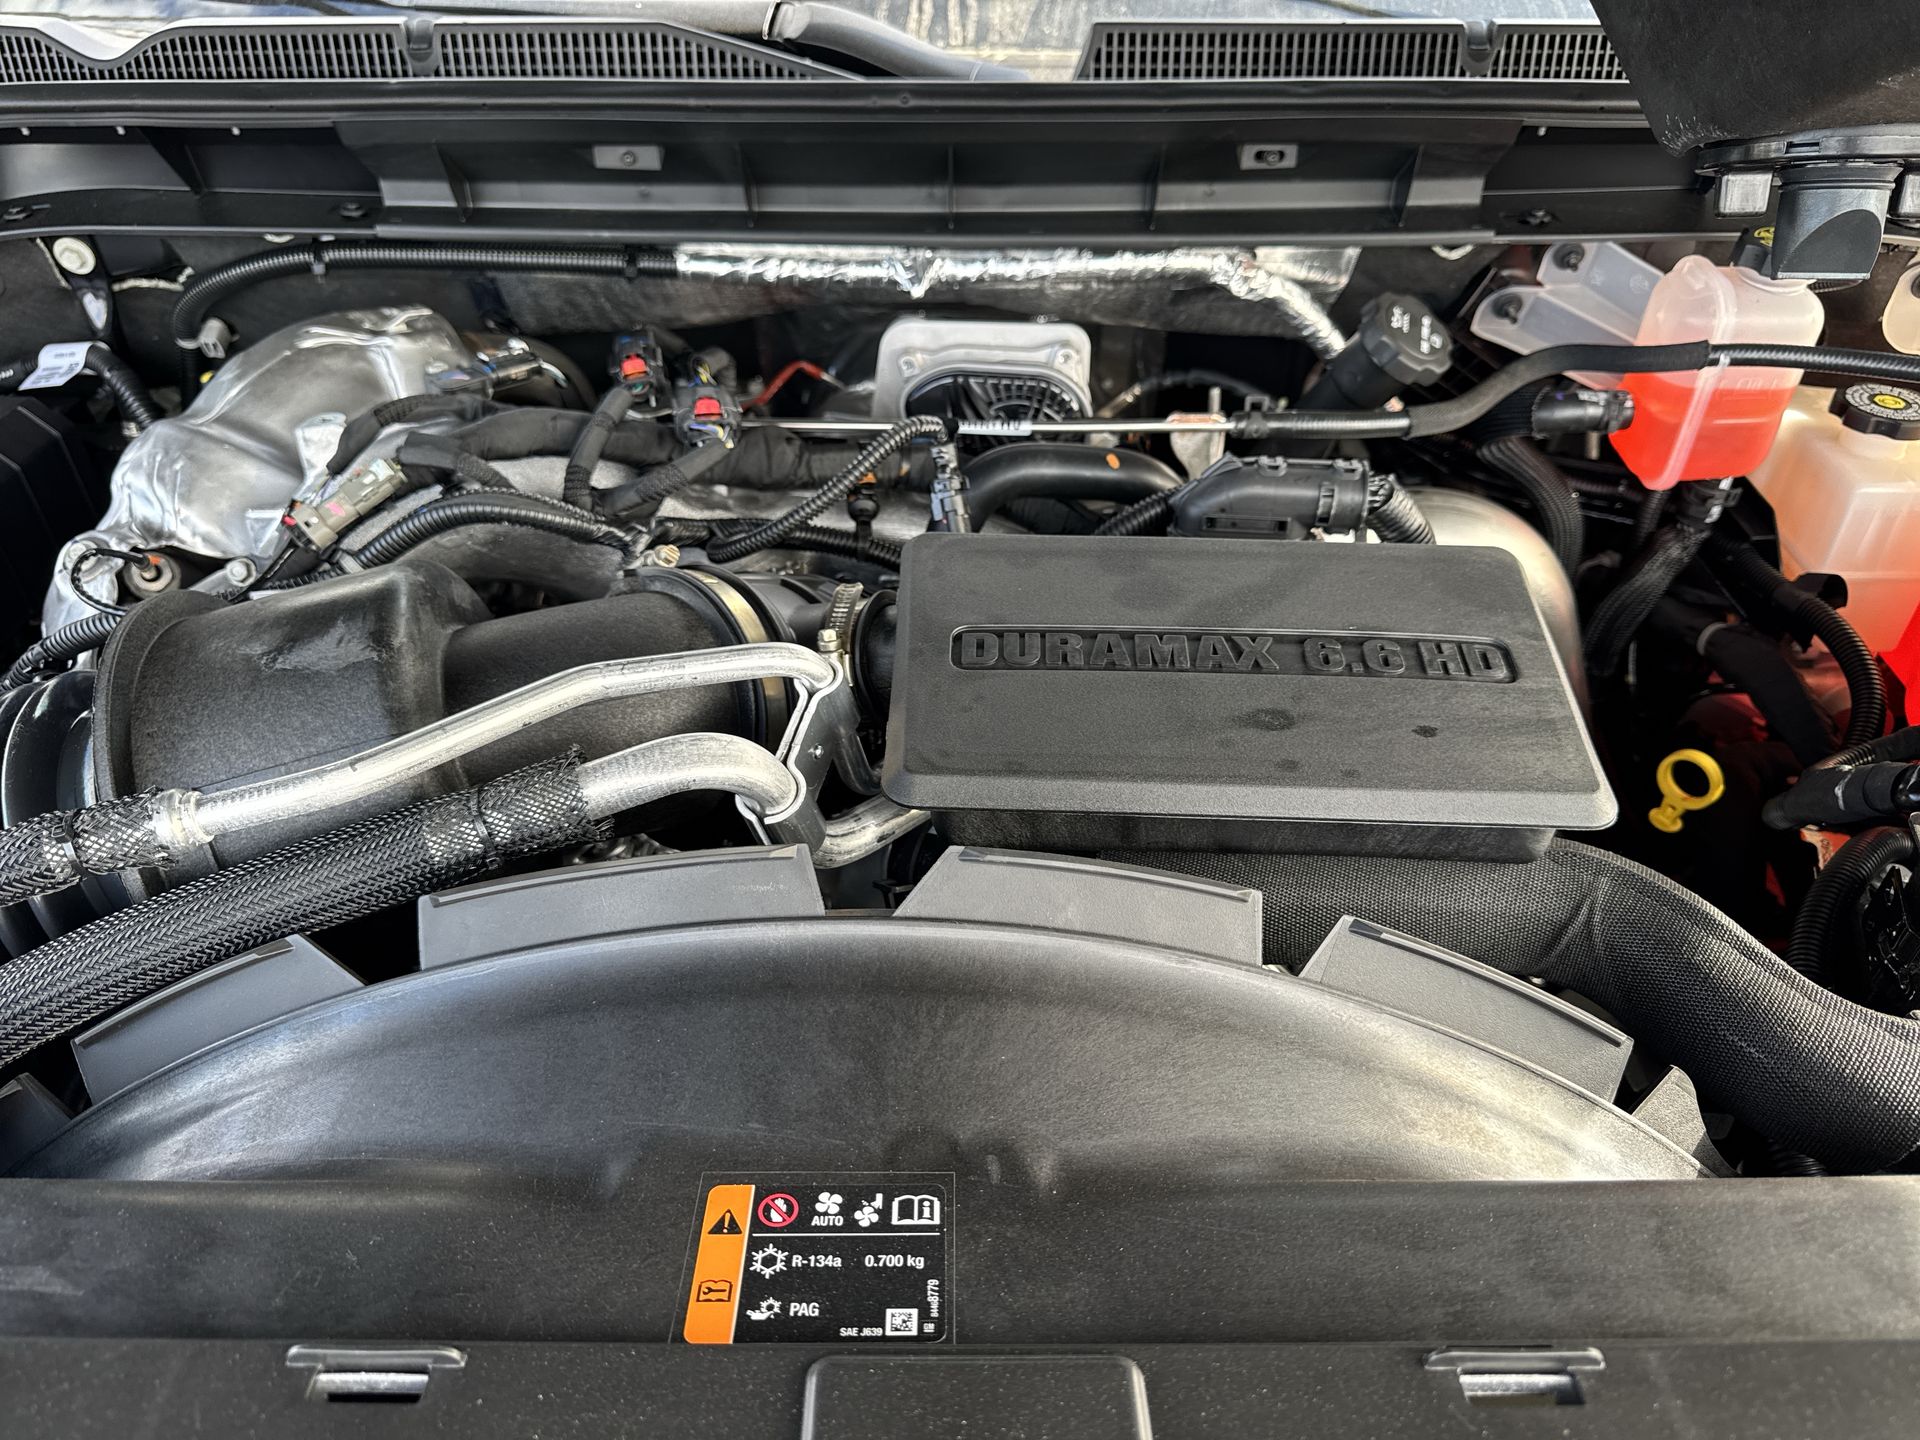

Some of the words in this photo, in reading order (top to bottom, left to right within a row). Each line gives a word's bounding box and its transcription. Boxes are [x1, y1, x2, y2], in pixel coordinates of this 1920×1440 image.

[961, 631, 1280, 670] DURAMAX
[1303, 637, 1406, 674] 6.6
[1417, 641, 1507, 677] HD
[811, 1215, 844, 1226] AUTO
[791, 1254, 842, 1268] R-134a
[864, 1254, 904, 1267] 0.700
[906, 1254, 925, 1269] kg
[789, 1303, 820, 1317] PAG
[839, 1327, 859, 1337] SAE
[860, 1327, 883, 1337] J639
